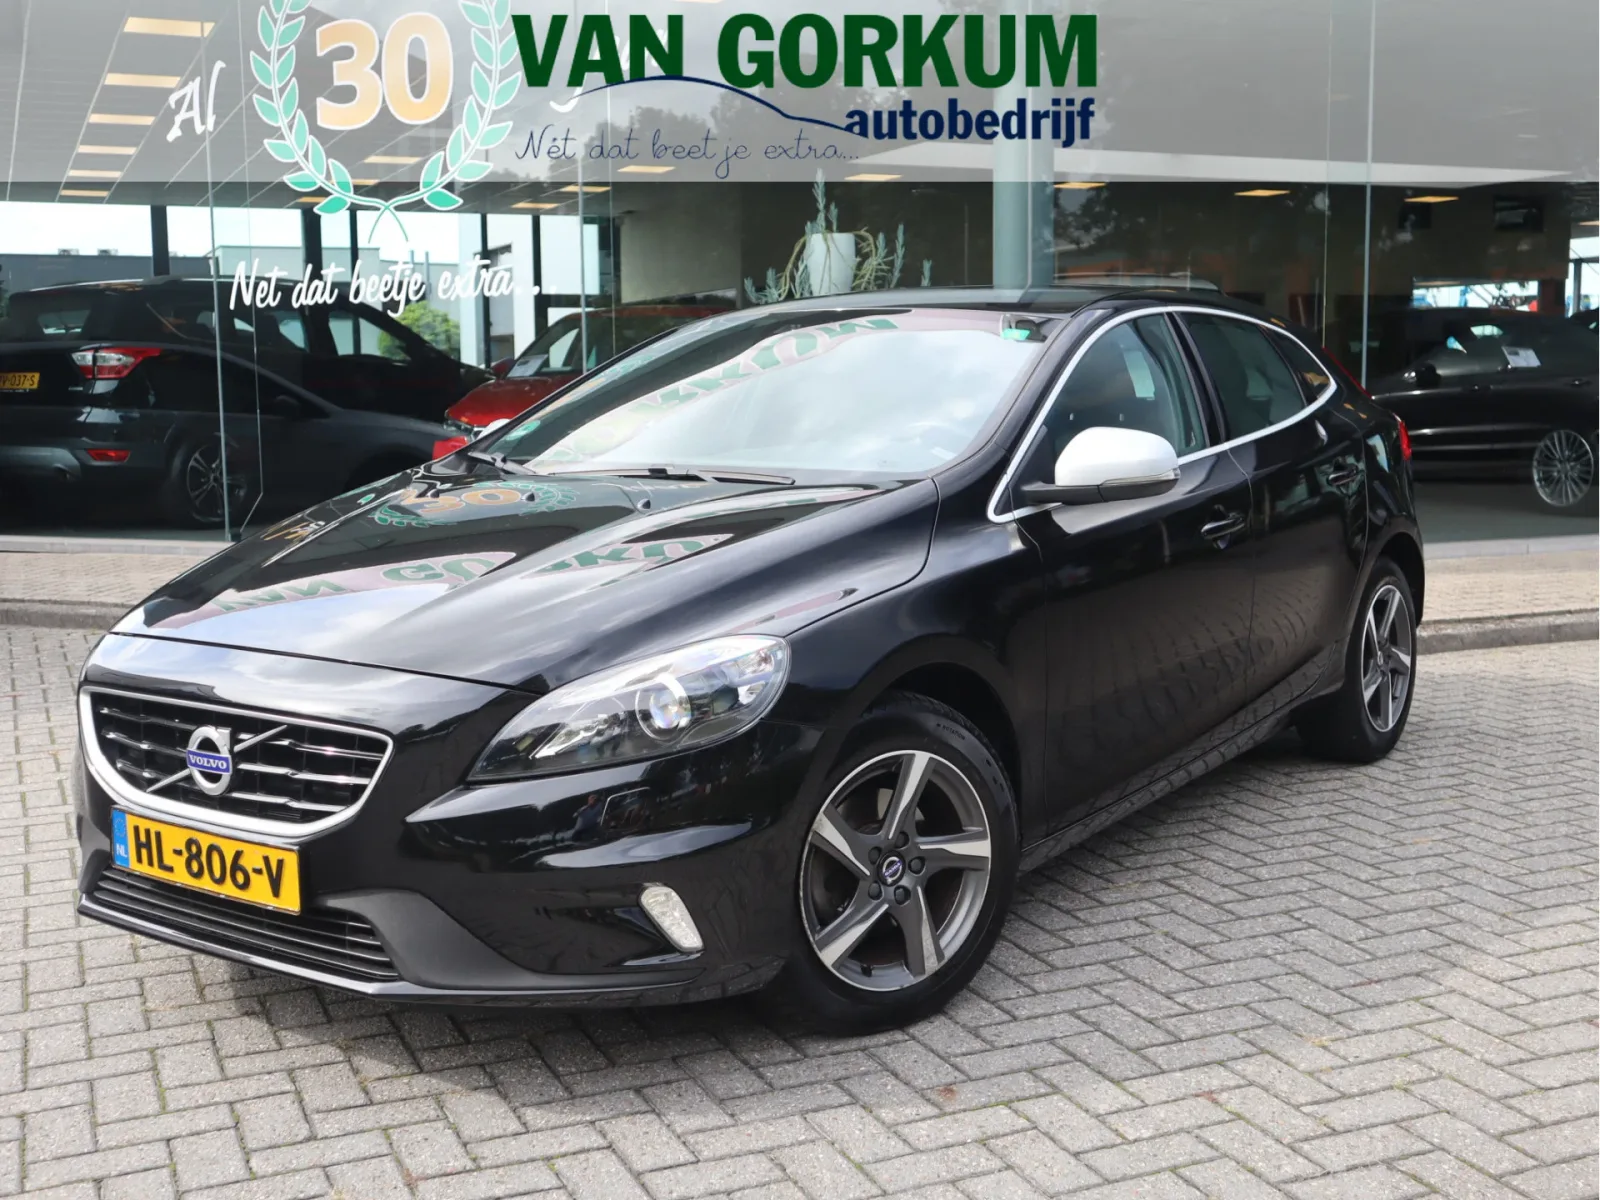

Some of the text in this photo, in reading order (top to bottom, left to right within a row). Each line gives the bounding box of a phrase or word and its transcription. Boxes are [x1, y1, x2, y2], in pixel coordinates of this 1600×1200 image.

[315, 12, 454, 130] 30
[229, 258, 288, 311] Net
[291, 263, 346, 308] dat
[349, 259, 427, 316] beetje
[0, 374, 36, 388] V-037-S
[188, 753, 228, 769] VOLVO
[116, 843, 128, 859] NL
[132, 824, 285, 899] HL-806-V
